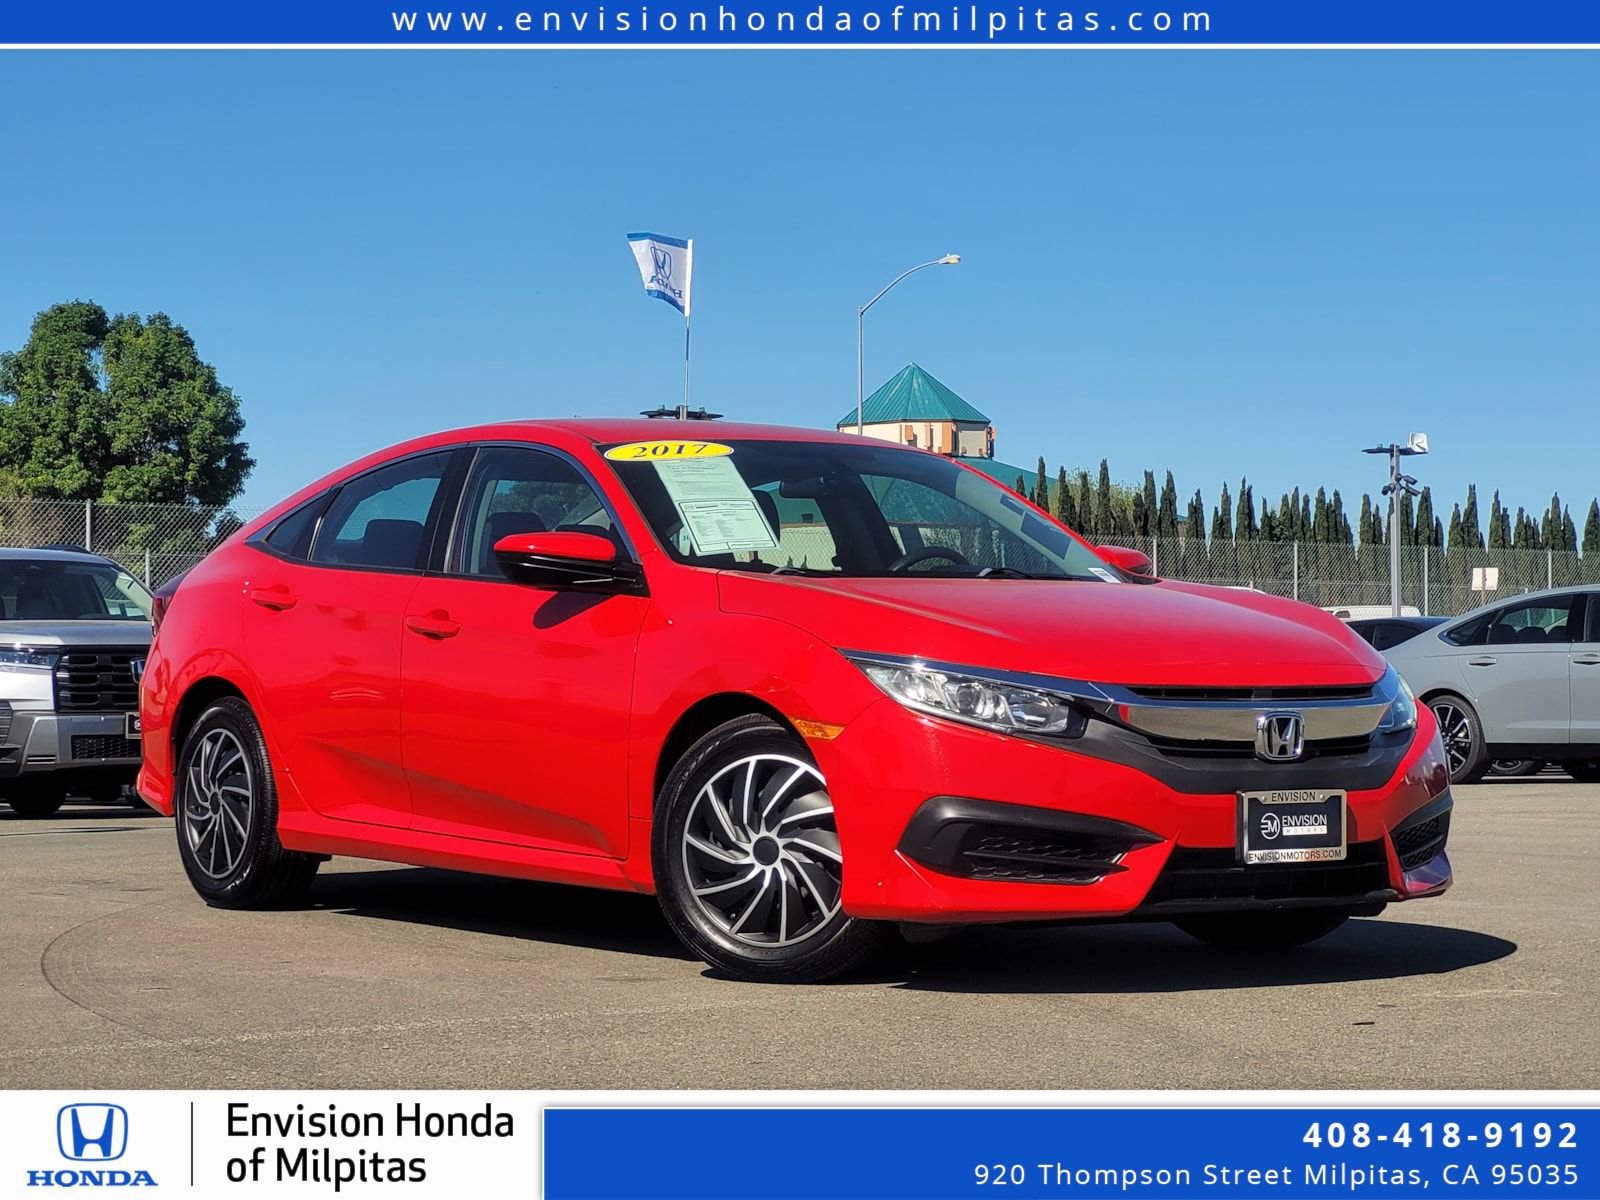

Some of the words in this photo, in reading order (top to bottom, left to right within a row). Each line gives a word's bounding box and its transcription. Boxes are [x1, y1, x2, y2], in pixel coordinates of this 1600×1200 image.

[632, 444, 708, 459] 2017
[1271, 791, 1316, 803] ENVISION
[1282, 814, 1327, 827] ENVISION
[1248, 849, 1342, 861] ENVISIONMOTORS.COM
